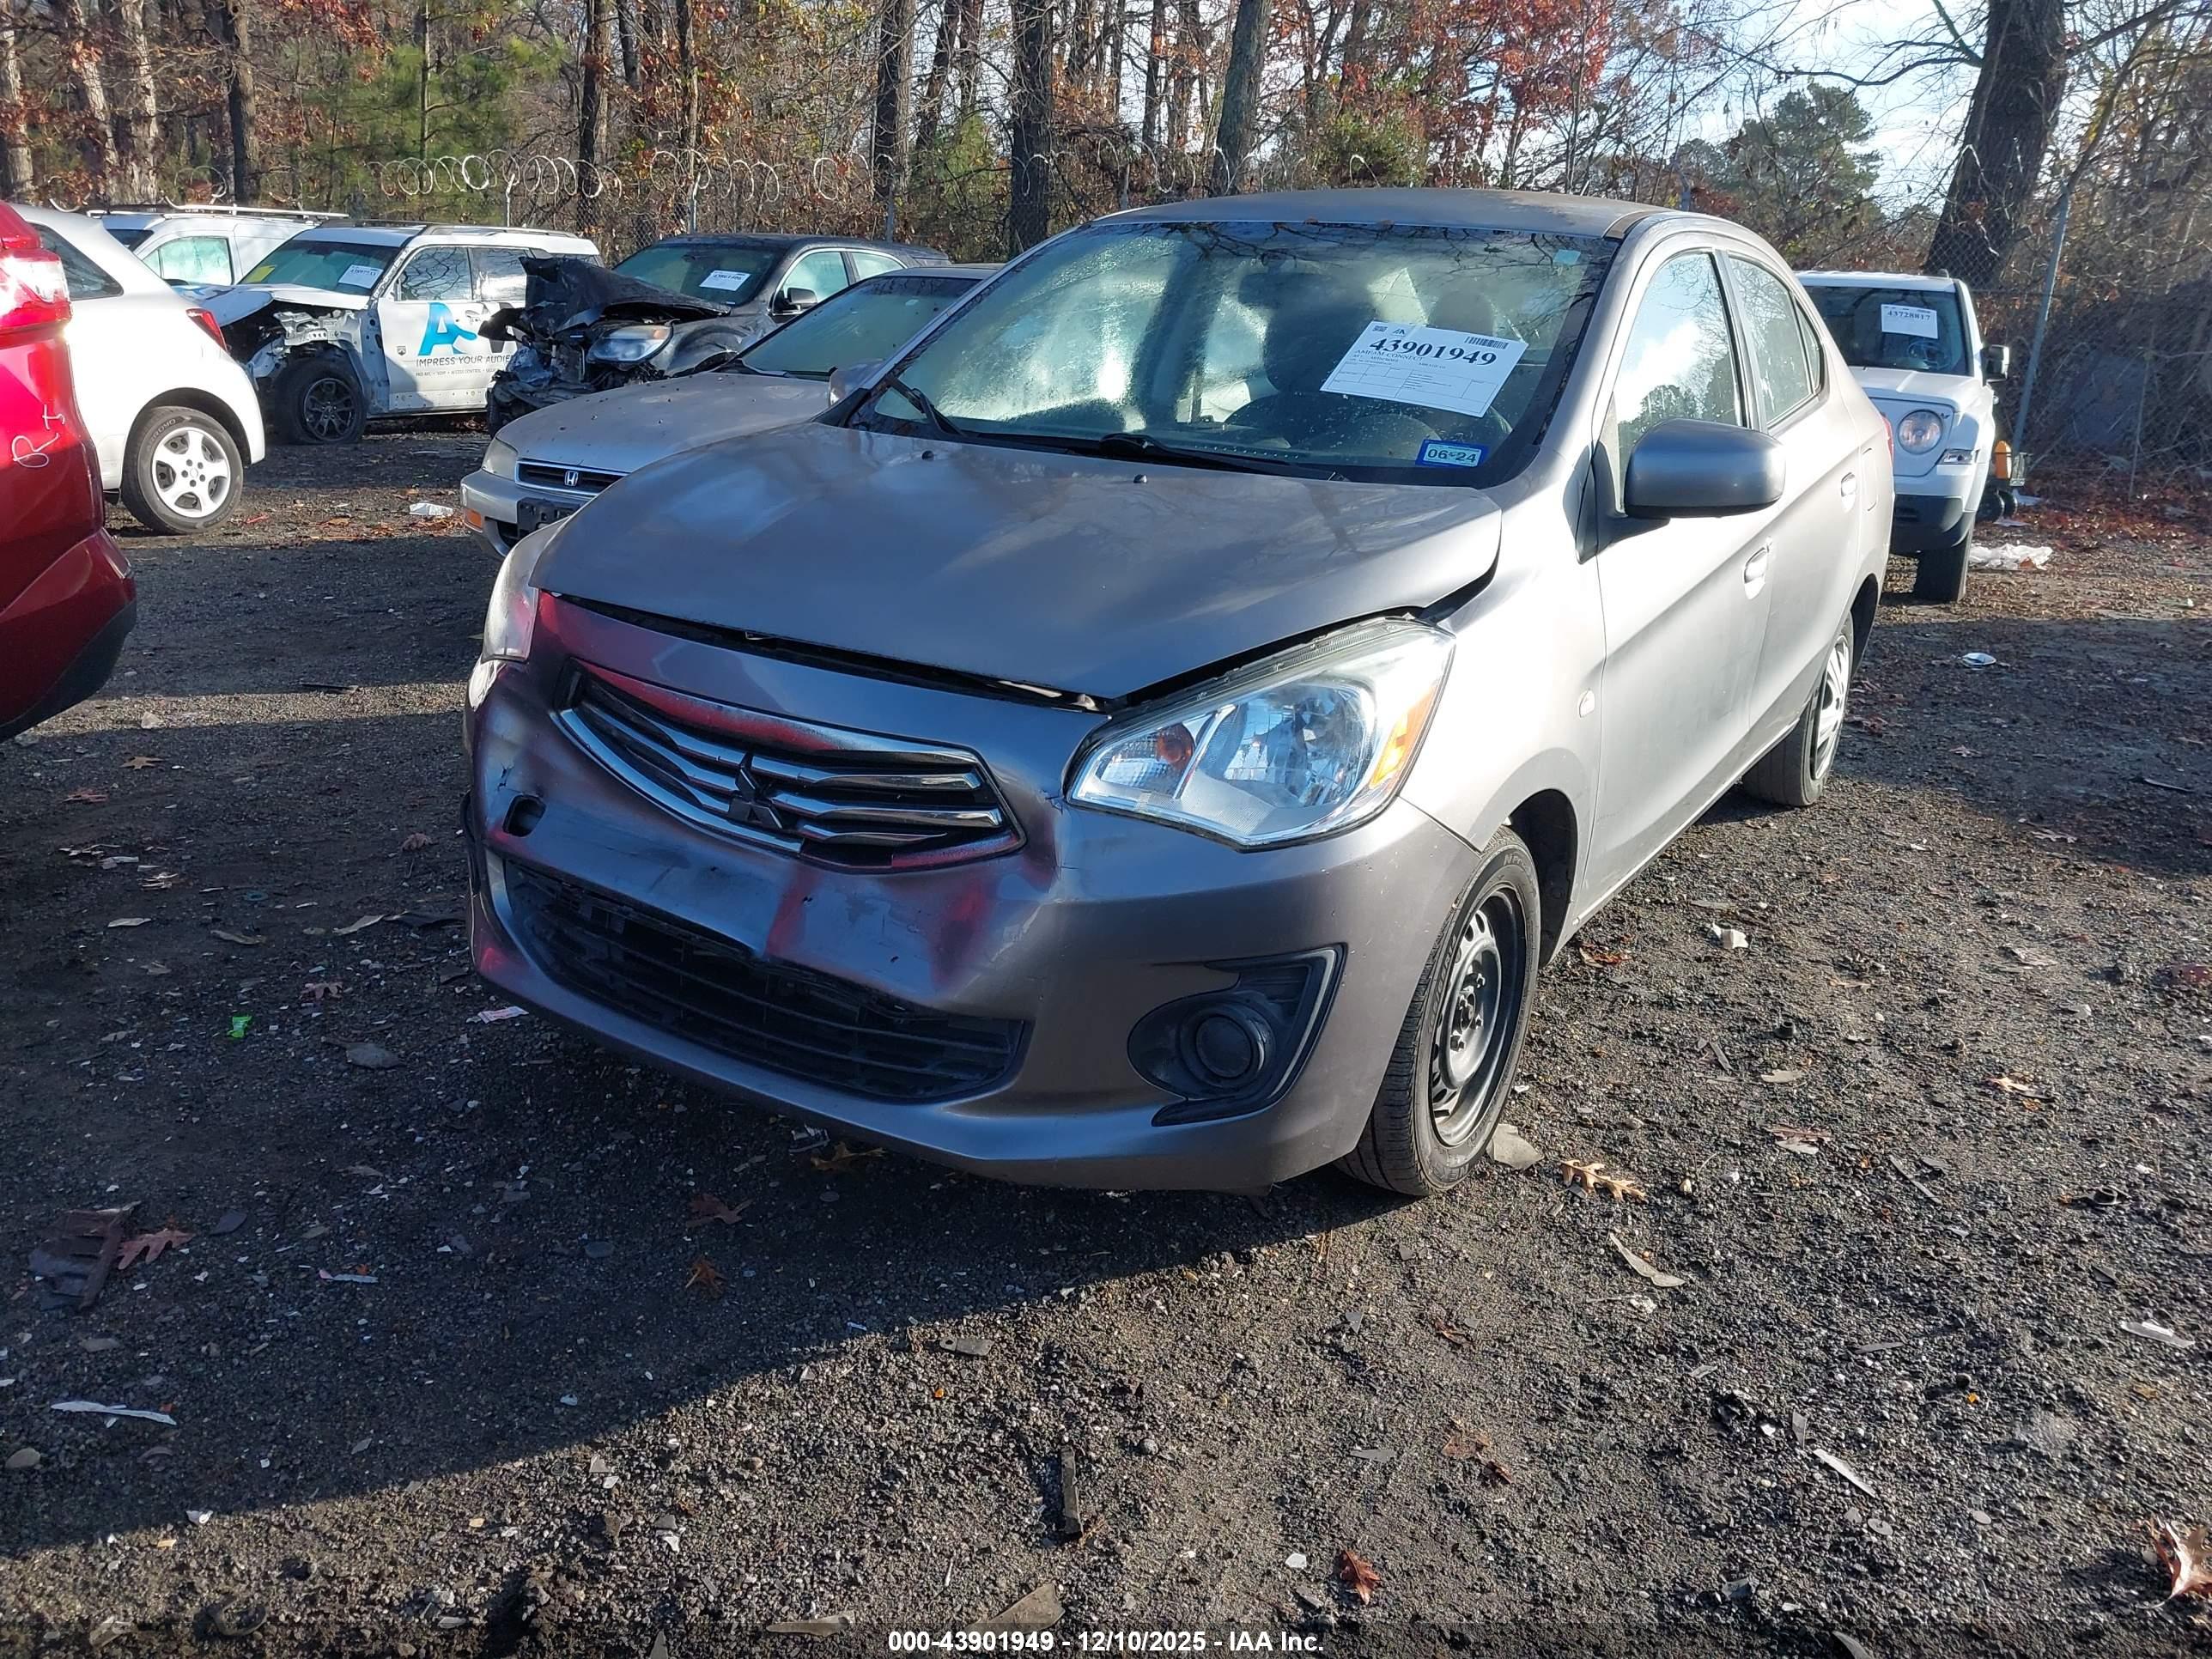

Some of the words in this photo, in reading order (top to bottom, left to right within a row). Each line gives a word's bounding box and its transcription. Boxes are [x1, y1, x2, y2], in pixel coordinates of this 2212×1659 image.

[416, 357, 455, 367] IMPRESS
[459, 356, 483, 364] YOUR
[485, 355, 514, 364] AUDIE
[1370, 337, 1497, 366] 43901949
